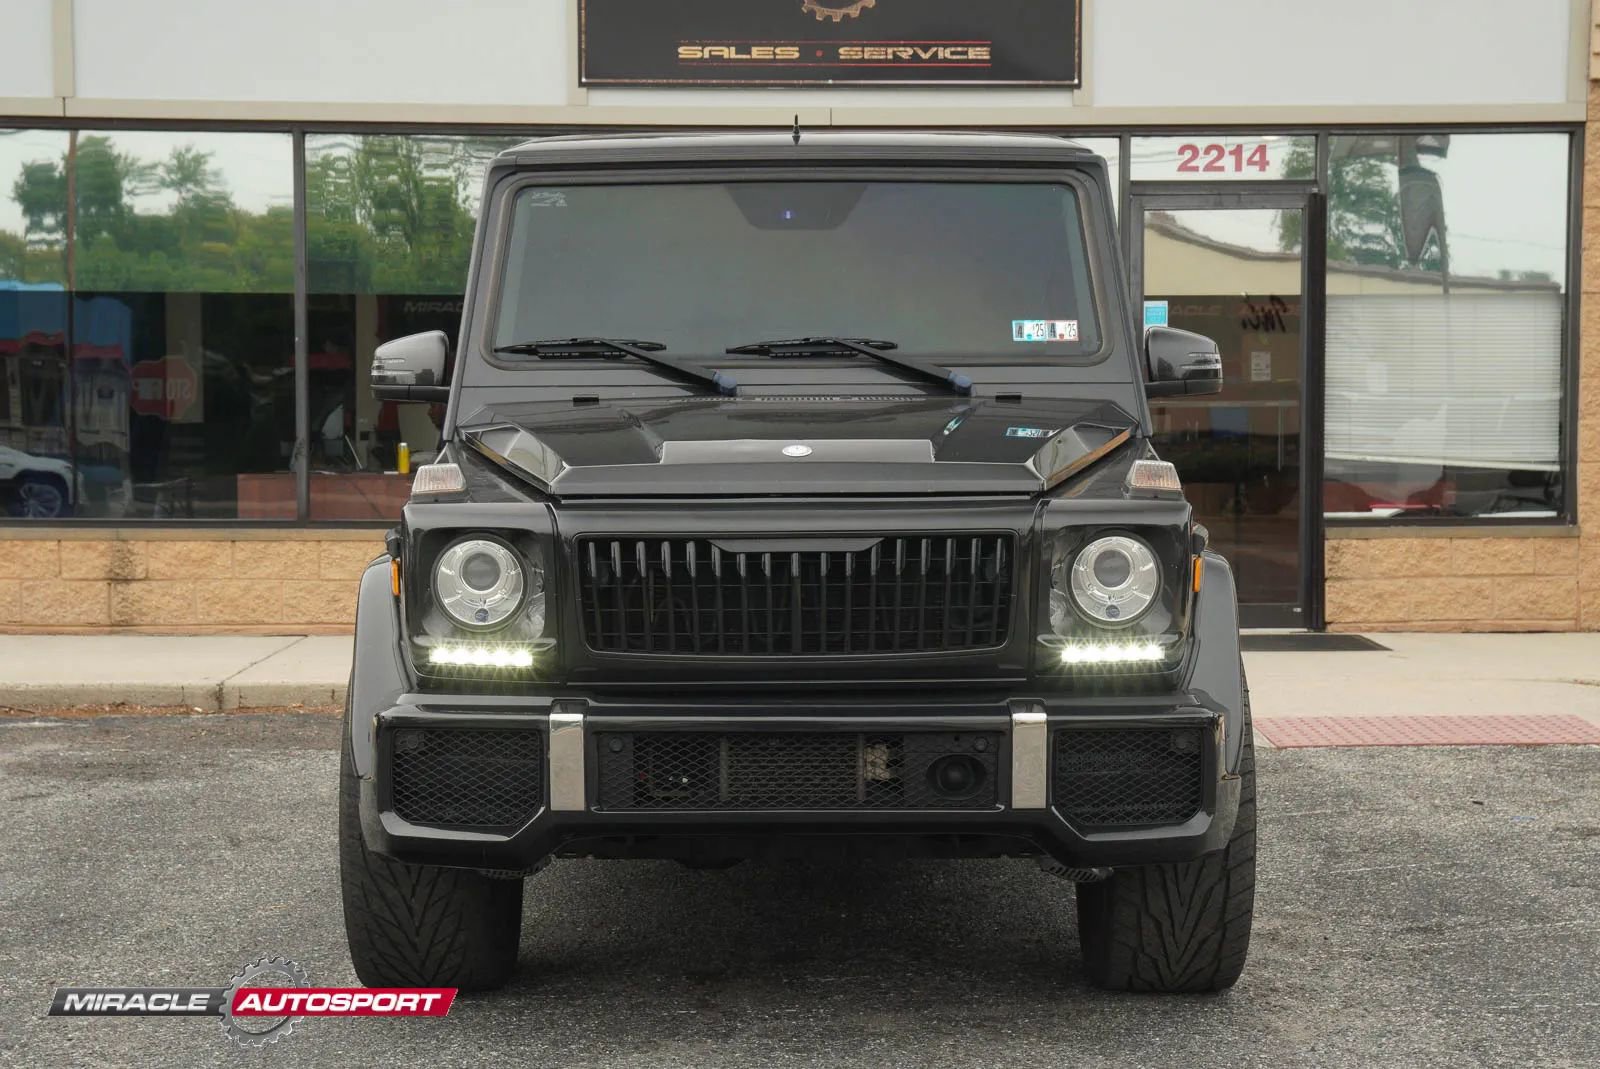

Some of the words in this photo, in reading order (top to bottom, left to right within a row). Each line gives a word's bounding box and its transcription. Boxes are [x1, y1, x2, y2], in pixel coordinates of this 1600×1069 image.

[677, 46, 800, 59] SALES
[838, 46, 991, 60] SERVICE
[1176, 143, 1270, 172] 2214
